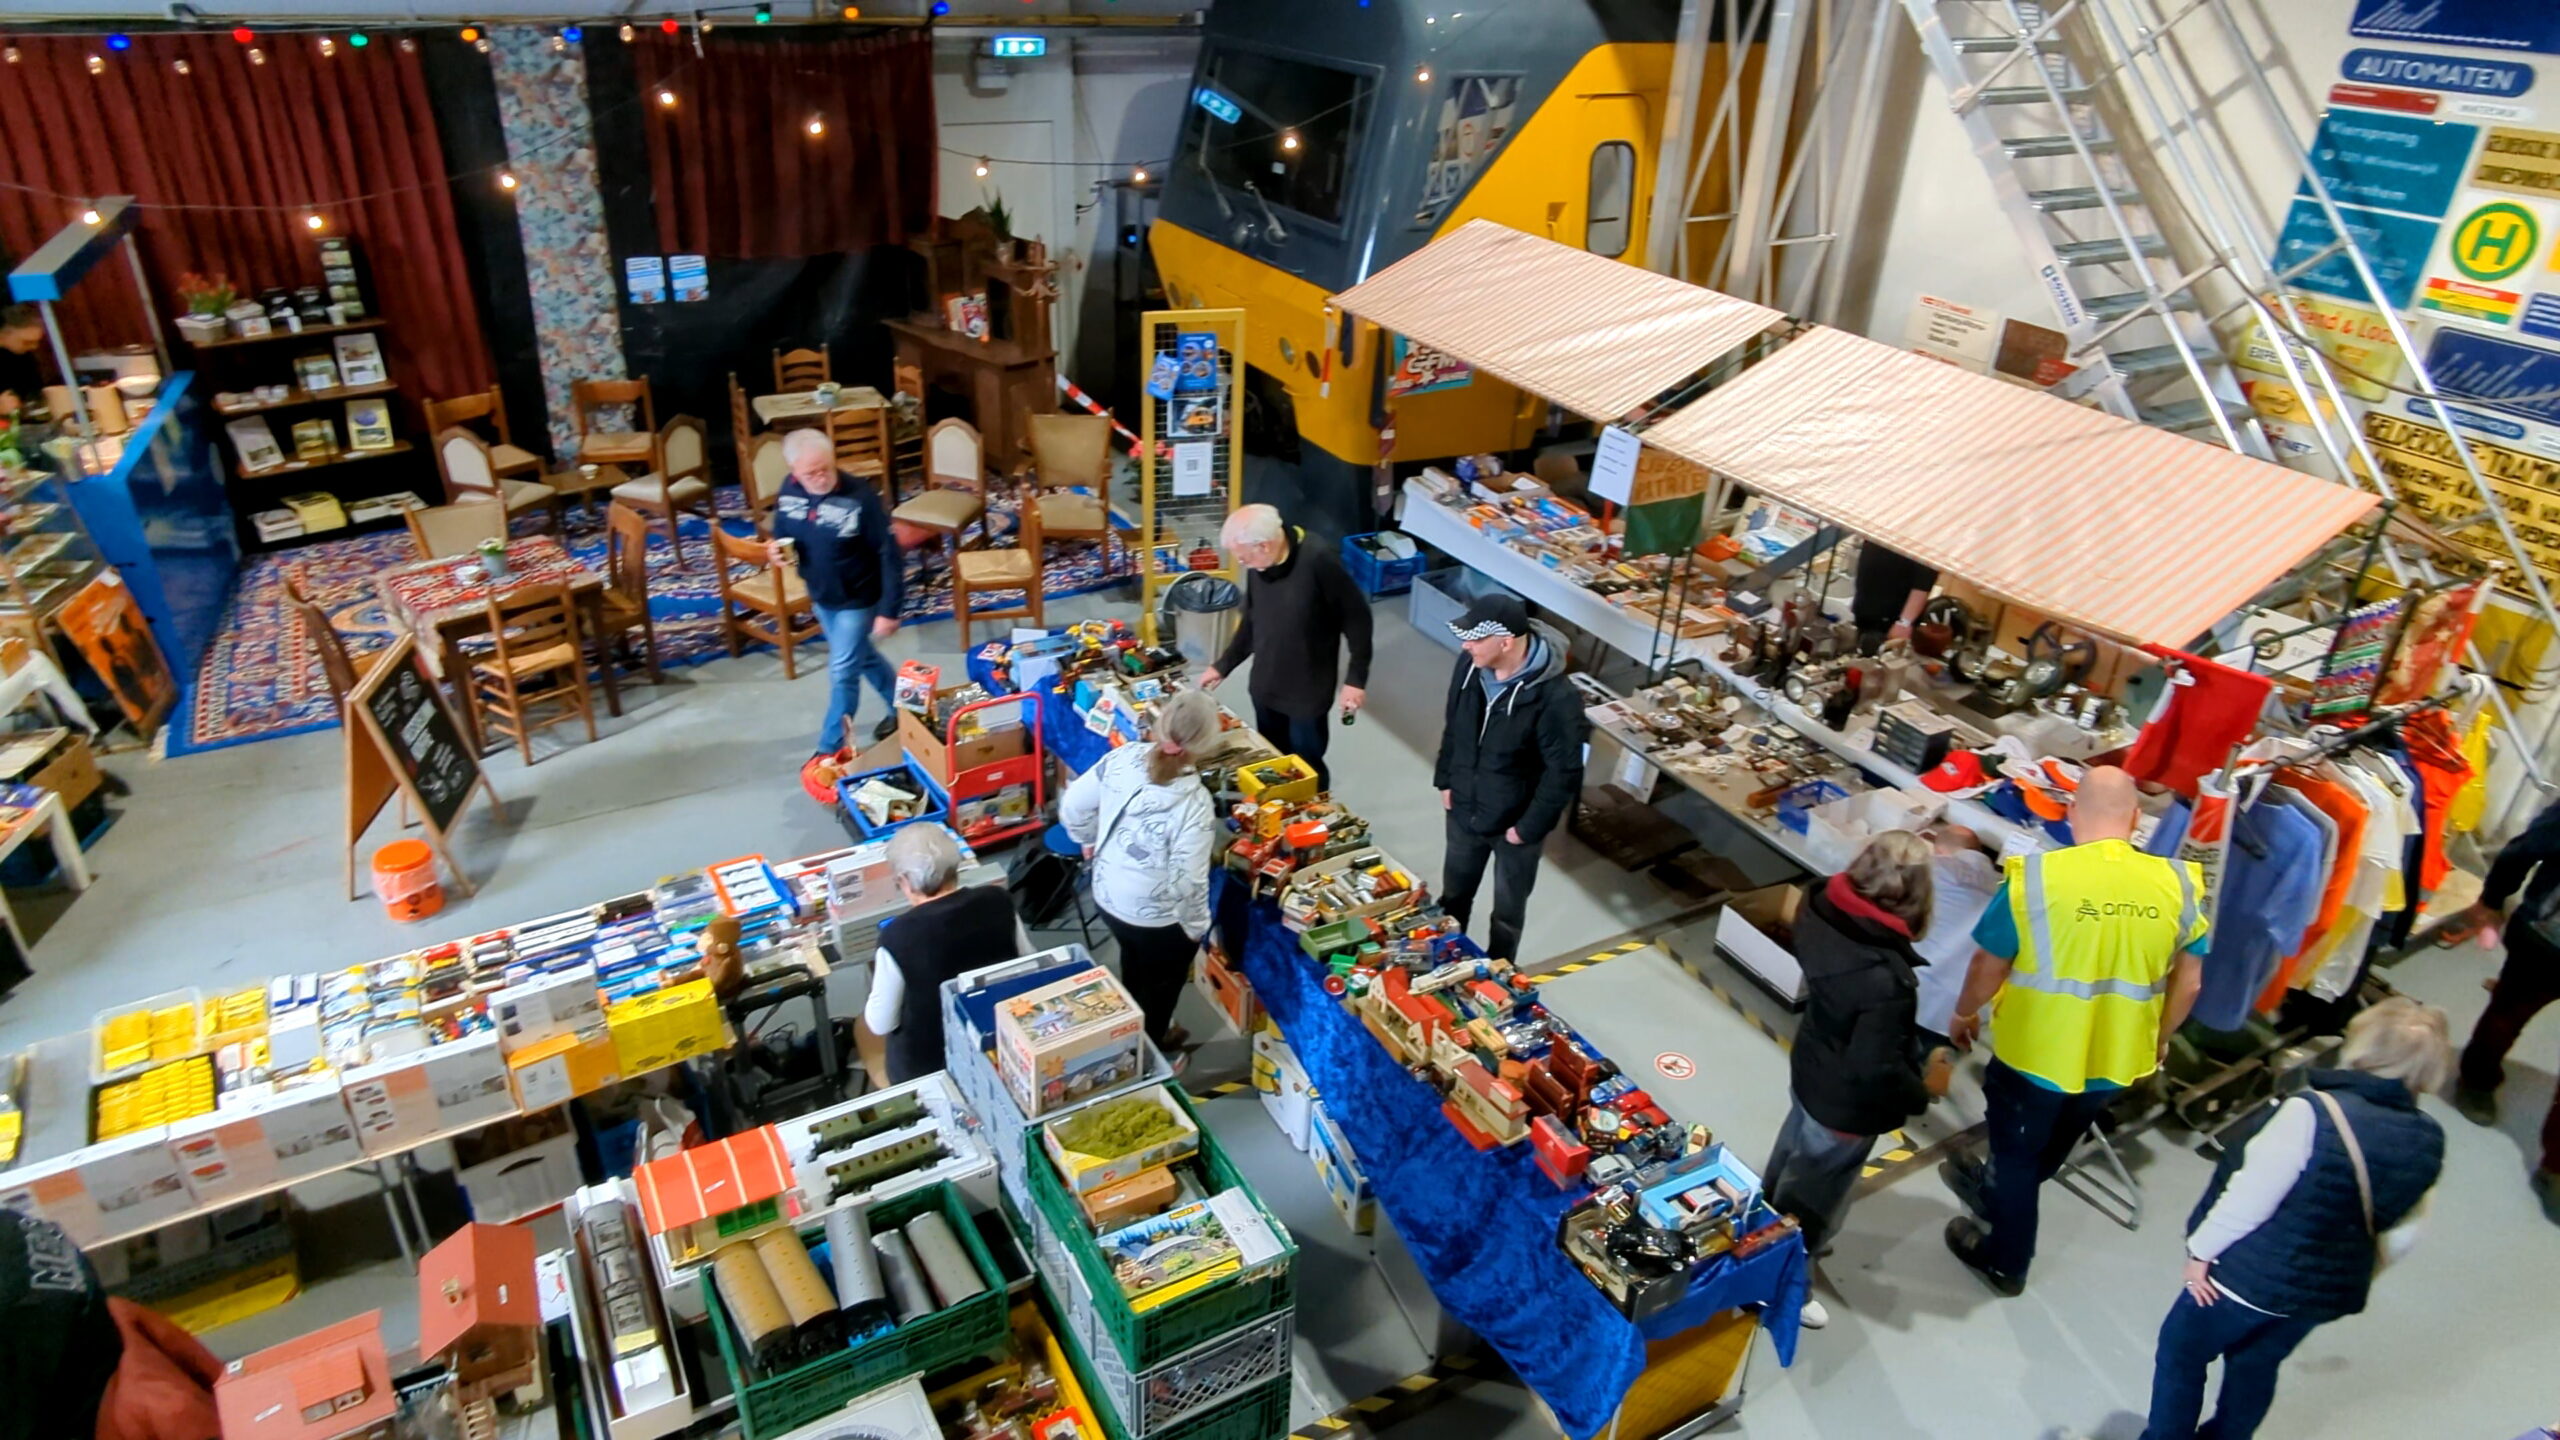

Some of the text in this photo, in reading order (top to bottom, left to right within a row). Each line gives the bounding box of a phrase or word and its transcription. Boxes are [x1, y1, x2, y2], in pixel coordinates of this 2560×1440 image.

[2354, 55, 2517, 91] AUTOMATEN
[2466, 218, 2520, 267] H
[2102, 900, 2160, 919] arriva
